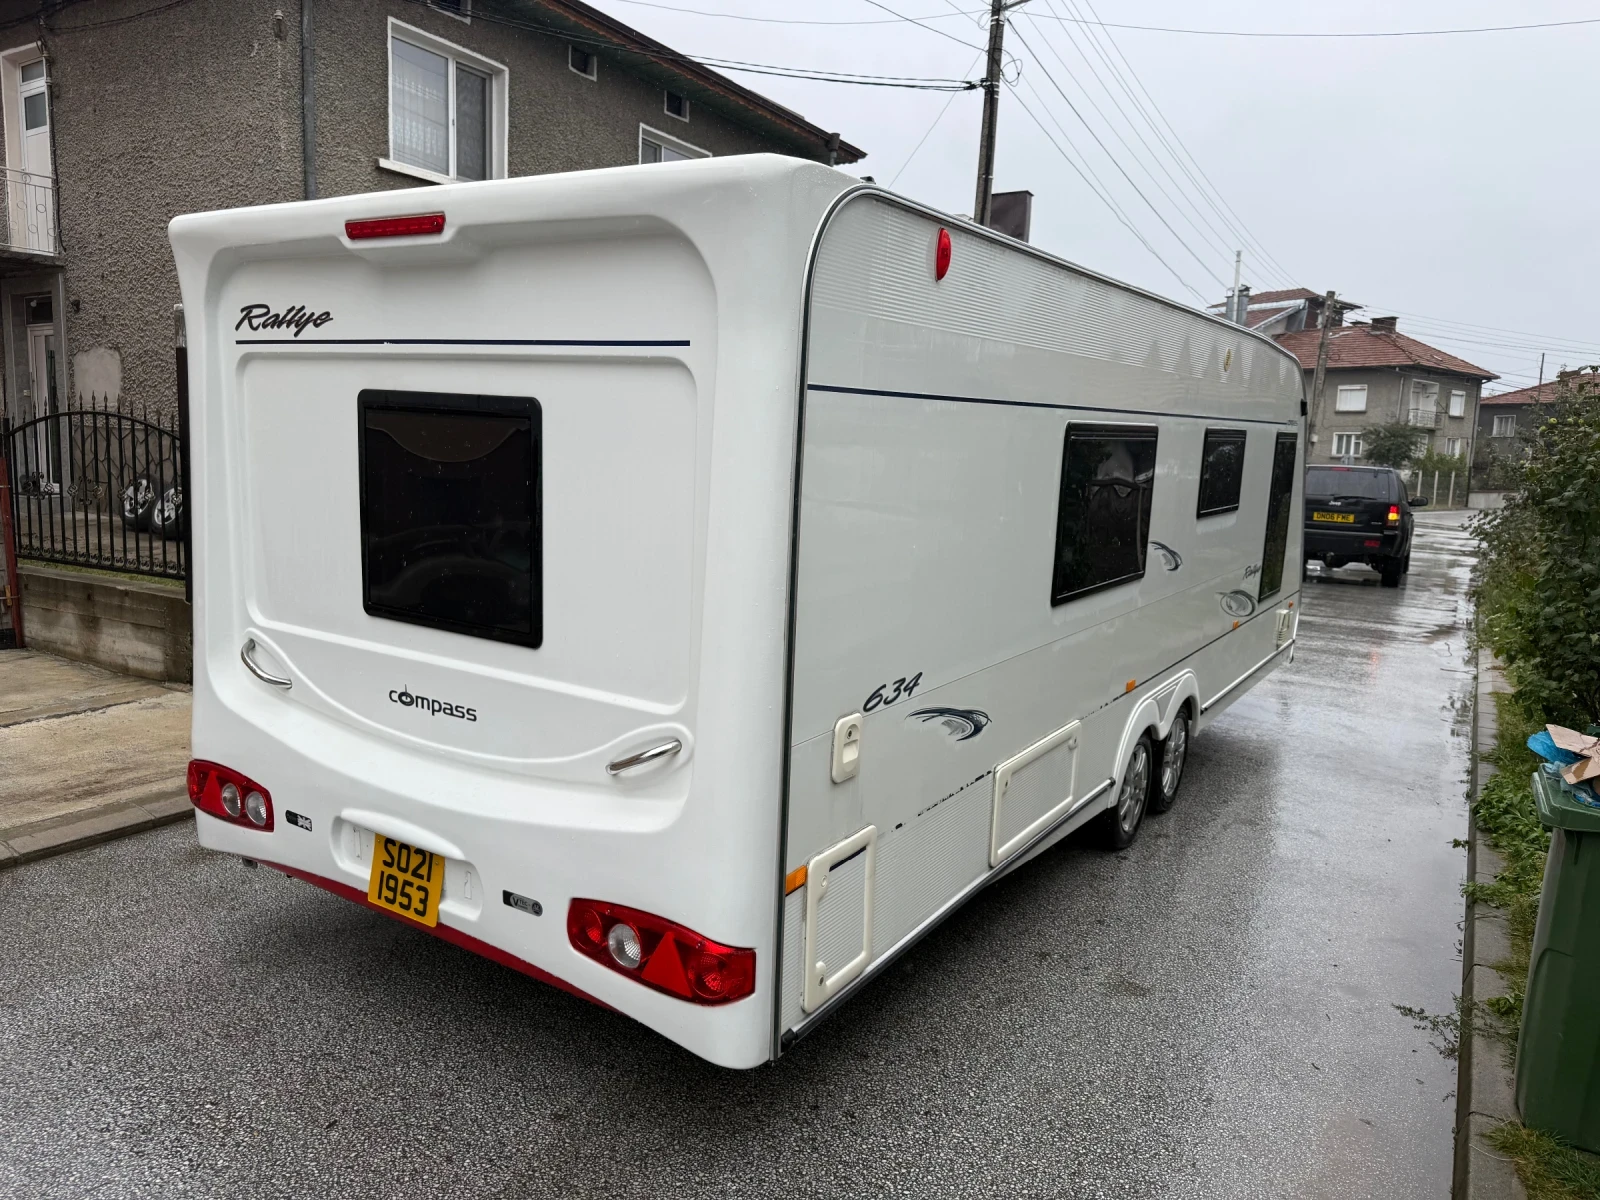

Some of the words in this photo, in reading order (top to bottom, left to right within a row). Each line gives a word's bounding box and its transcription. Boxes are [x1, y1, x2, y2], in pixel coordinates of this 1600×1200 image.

[235, 303, 334, 338] Rallye
[388, 683, 478, 722] compass
[863, 671, 923, 712] 634
[377, 870, 429, 917] 1953
